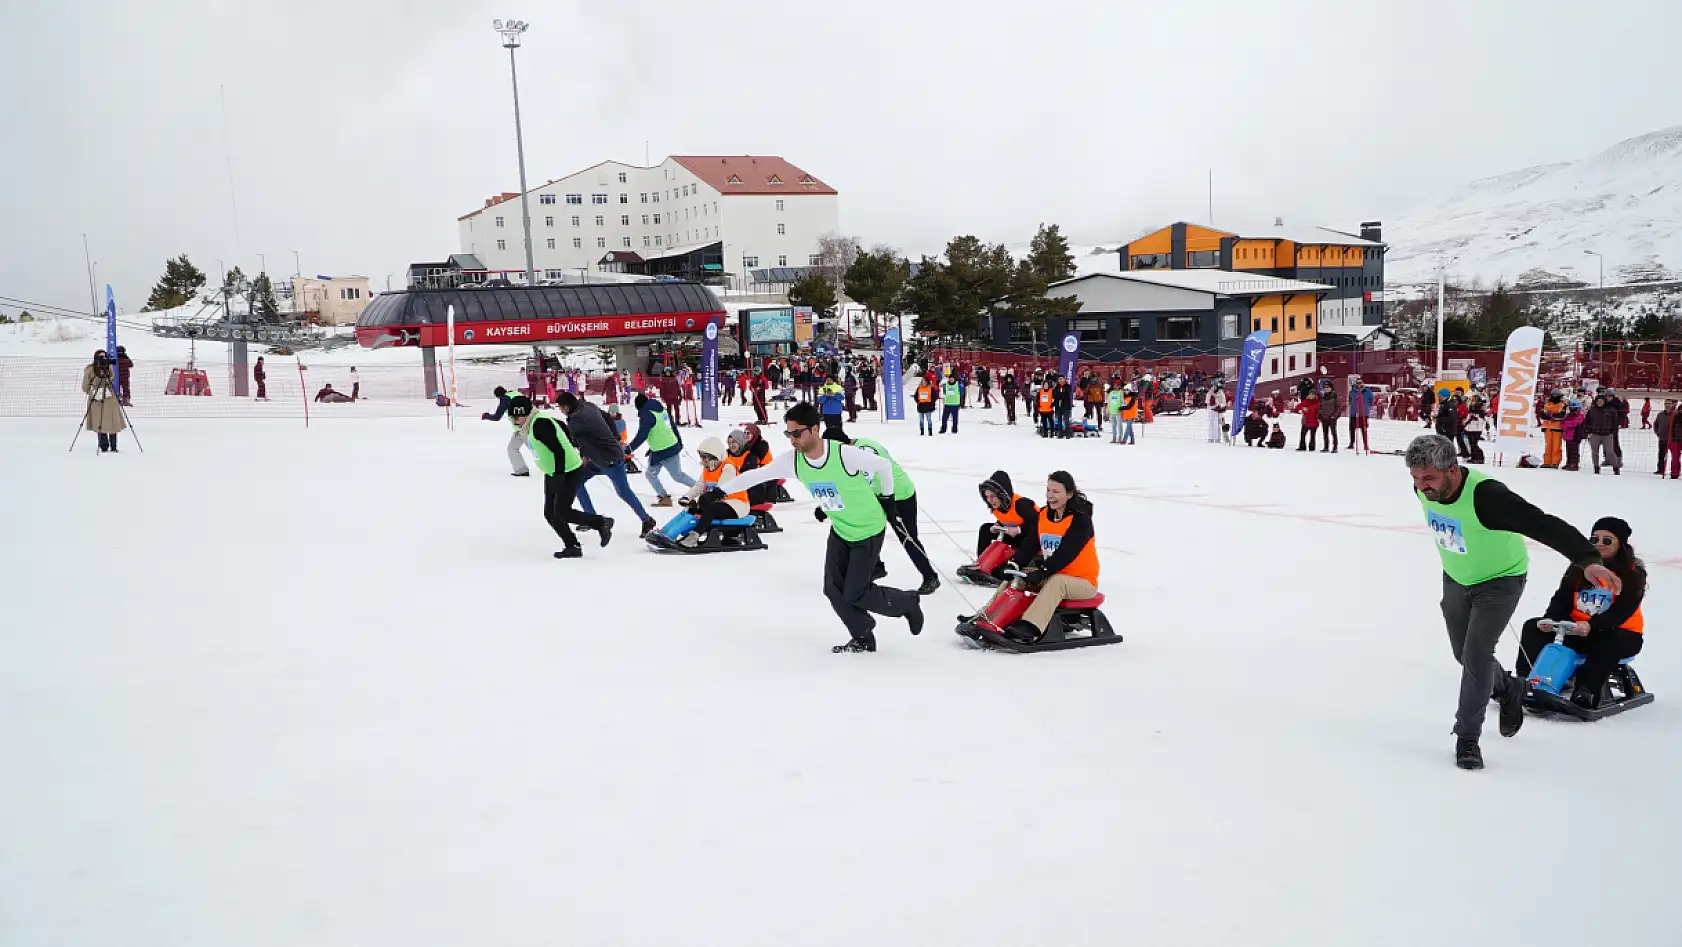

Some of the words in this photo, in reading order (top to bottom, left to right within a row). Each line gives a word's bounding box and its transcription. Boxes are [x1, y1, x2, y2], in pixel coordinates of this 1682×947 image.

[486, 324, 530, 336] KAYSERİ
[546, 320, 609, 334] BÜYÜKŞEHİR
[624, 317, 676, 329] BELEDİYESİ
[1500, 346, 1540, 439] HUMA
[1431, 519, 1456, 537] 017
[1582, 592, 1607, 605] 017
